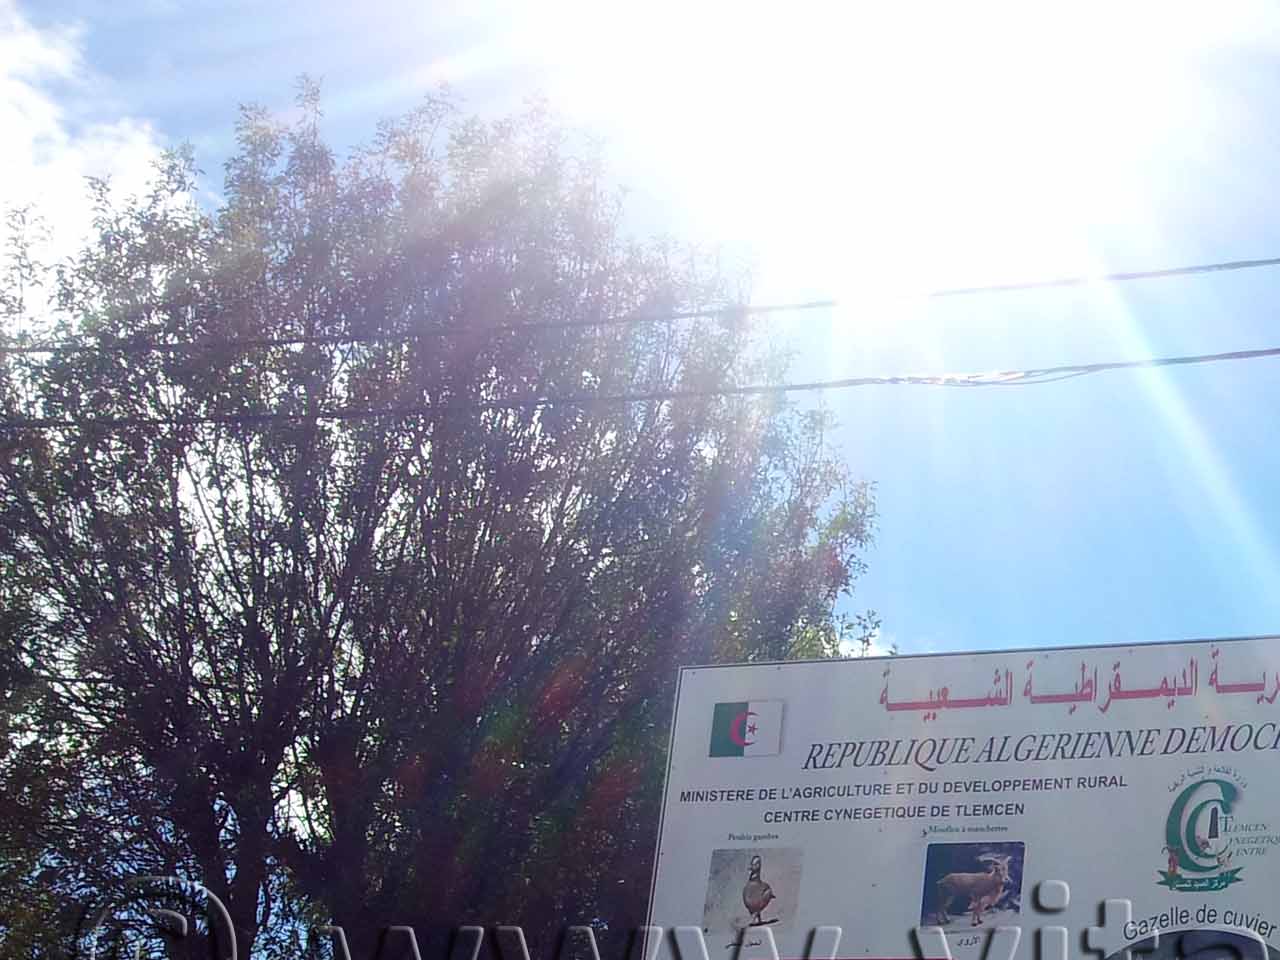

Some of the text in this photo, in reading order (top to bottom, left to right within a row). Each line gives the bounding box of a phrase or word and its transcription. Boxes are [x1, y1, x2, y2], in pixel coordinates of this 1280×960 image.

[880, 667, 1013, 721] الشعبية
[1024, 656, 1198, 715] الديمقراطية
[801, 737, 976, 773] REPUBLIQUE
[974, 728, 1160, 764] ALGERIENNE
[680, 775, 1128, 802] MINISTERE DE L'AGRICULTURE ET DU DEVELOPPEMENT RURAL
[764, 803, 1025, 823] CENTRE CYNEGETIQUE DE TLEMCEN
[1123, 903, 1278, 941] Gazelle de cuvier
